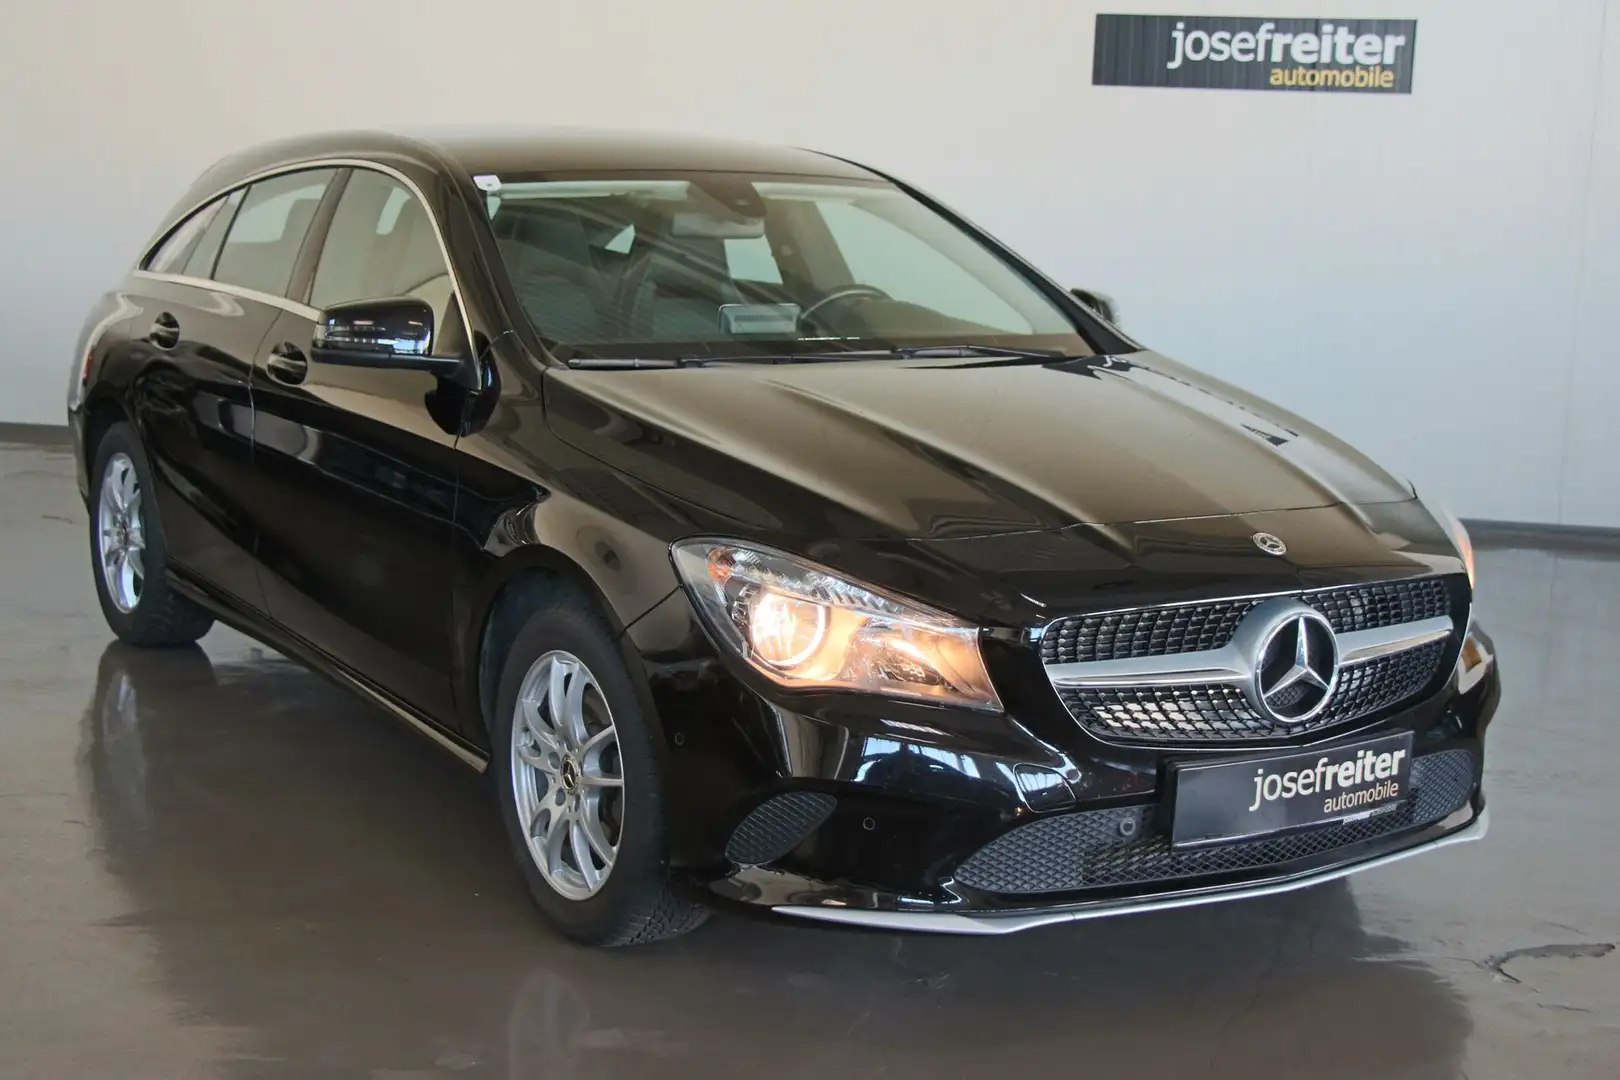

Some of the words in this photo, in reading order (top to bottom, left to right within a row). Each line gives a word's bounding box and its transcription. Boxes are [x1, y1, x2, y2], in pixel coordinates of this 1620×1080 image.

[1167, 22, 1406, 69] josefreiter
[1270, 66, 1394, 88] automobile
[1249, 750, 1406, 811] josefreiter
[1323, 780, 1399, 813] automobile
